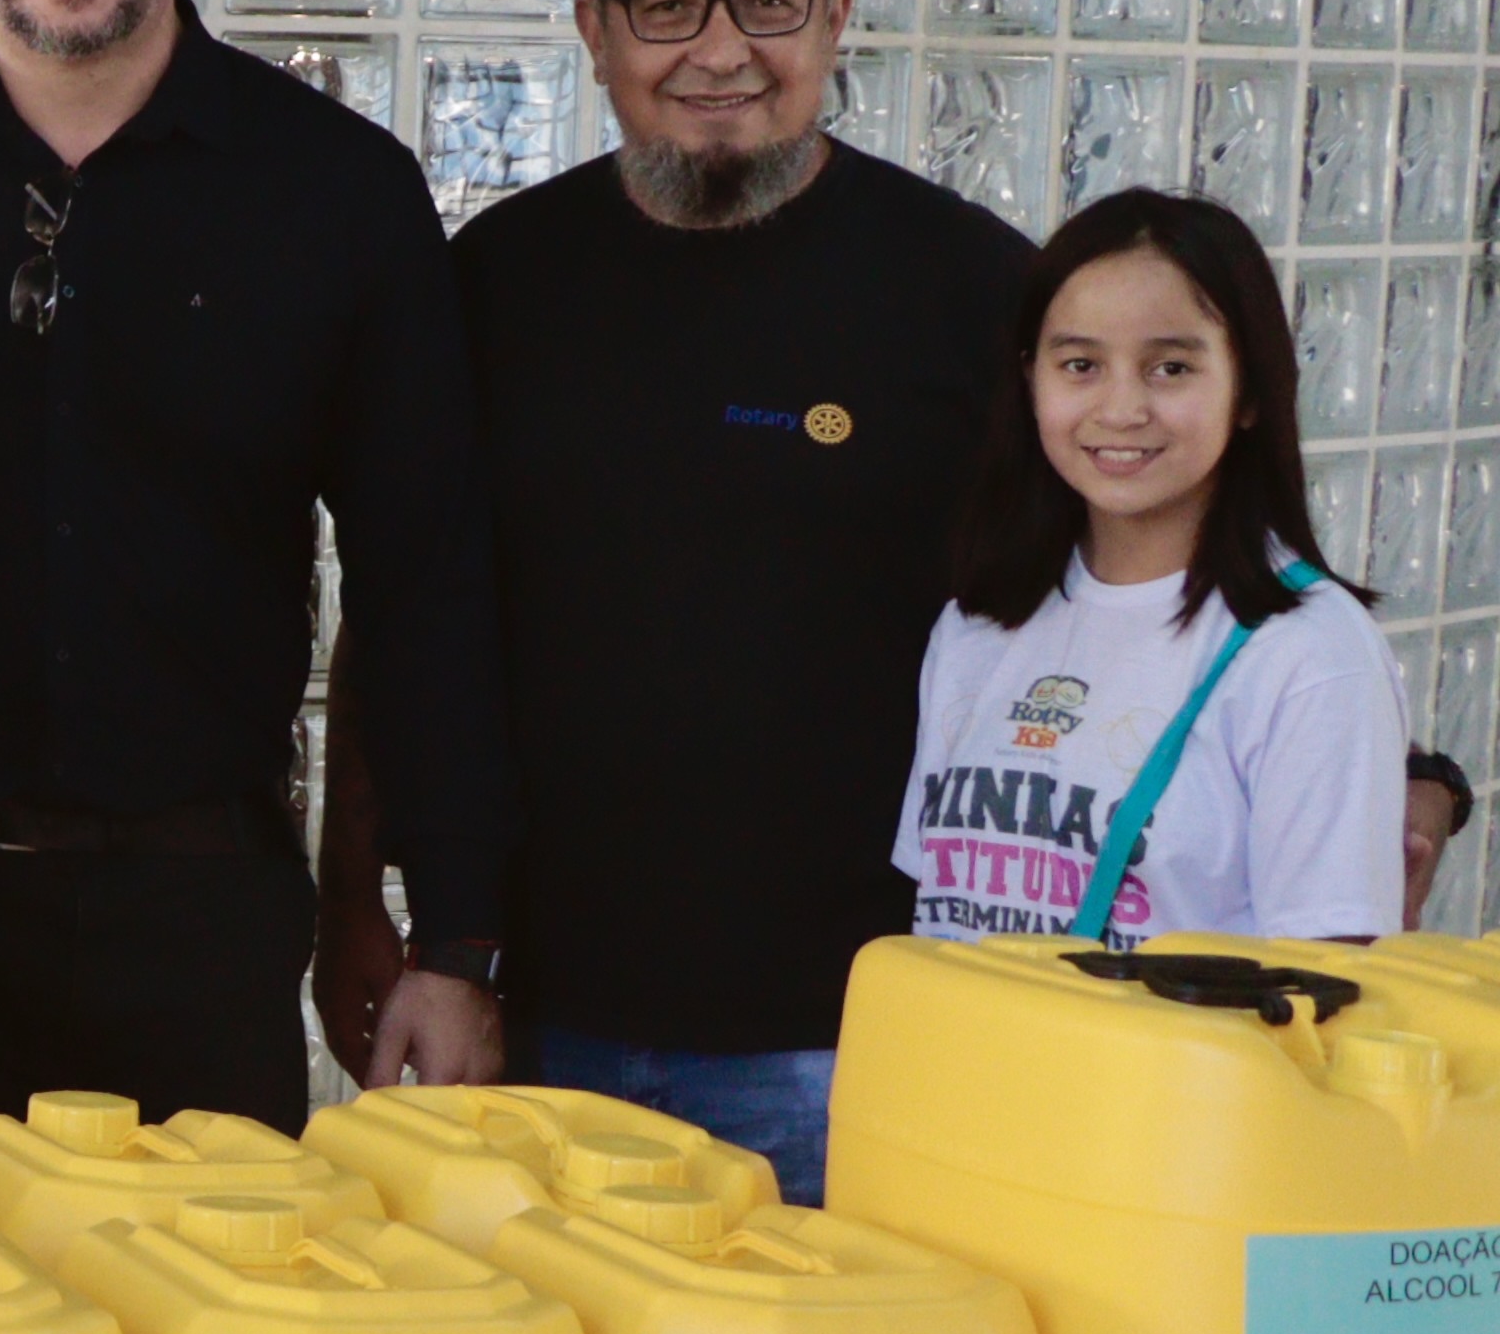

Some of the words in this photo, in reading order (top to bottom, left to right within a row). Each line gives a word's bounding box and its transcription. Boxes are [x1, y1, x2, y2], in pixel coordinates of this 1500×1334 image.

[725, 405, 799, 431] Rotary
[919, 837, 1150, 925] TITUDS
[1365, 1273, 1482, 1303] ALCOOL
